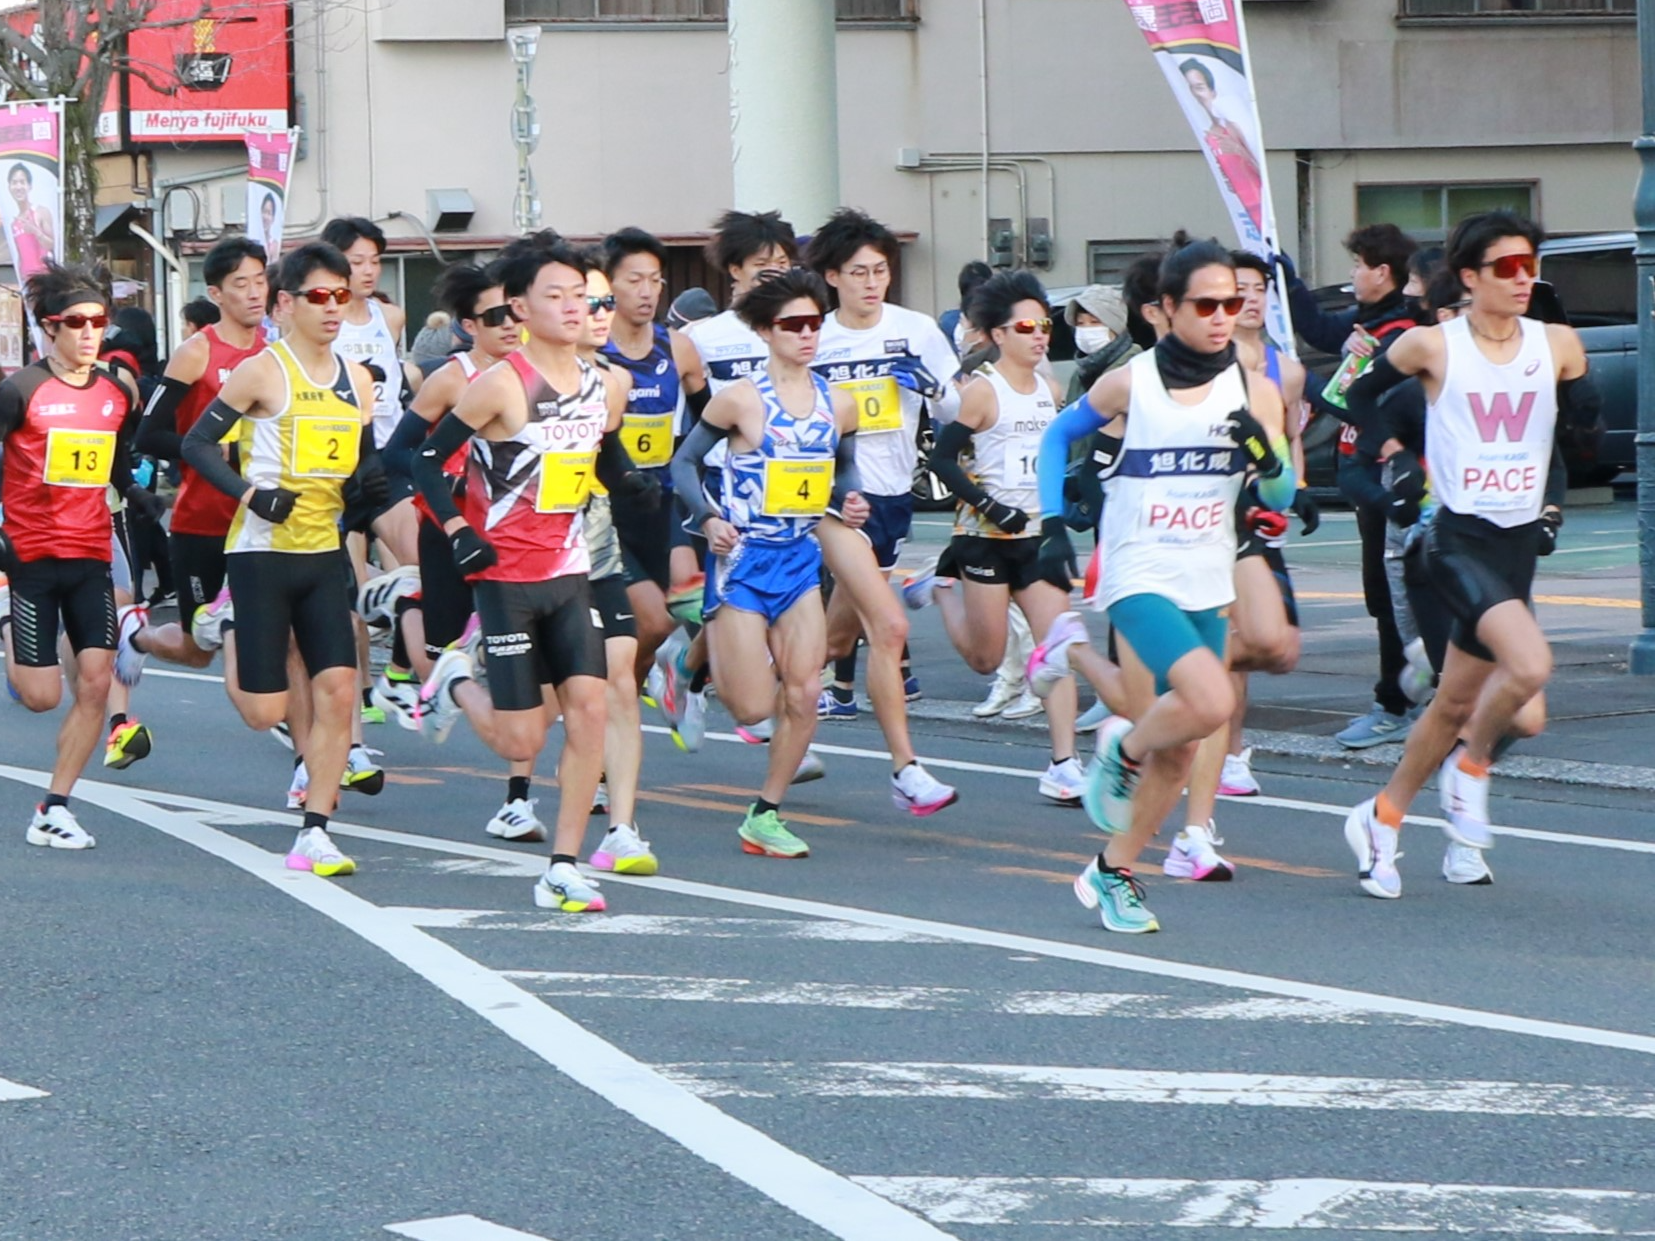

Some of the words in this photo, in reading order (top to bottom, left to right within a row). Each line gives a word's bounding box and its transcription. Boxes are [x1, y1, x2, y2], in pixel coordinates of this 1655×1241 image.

[146, 113, 199, 131] Menya
[204, 112, 267, 131] fujifuku
[1466, 392, 1538, 443] W
[327, 438, 339, 460] 2
[637, 434, 651, 453] 6
[72, 450, 97, 471] 13
[575, 471, 586, 494] 7
[797, 479, 810, 500] 4
[1464, 466, 1536, 492] PACE
[1149, 501, 1225, 529] PACE
[486, 632, 531, 644] TOYOTA
